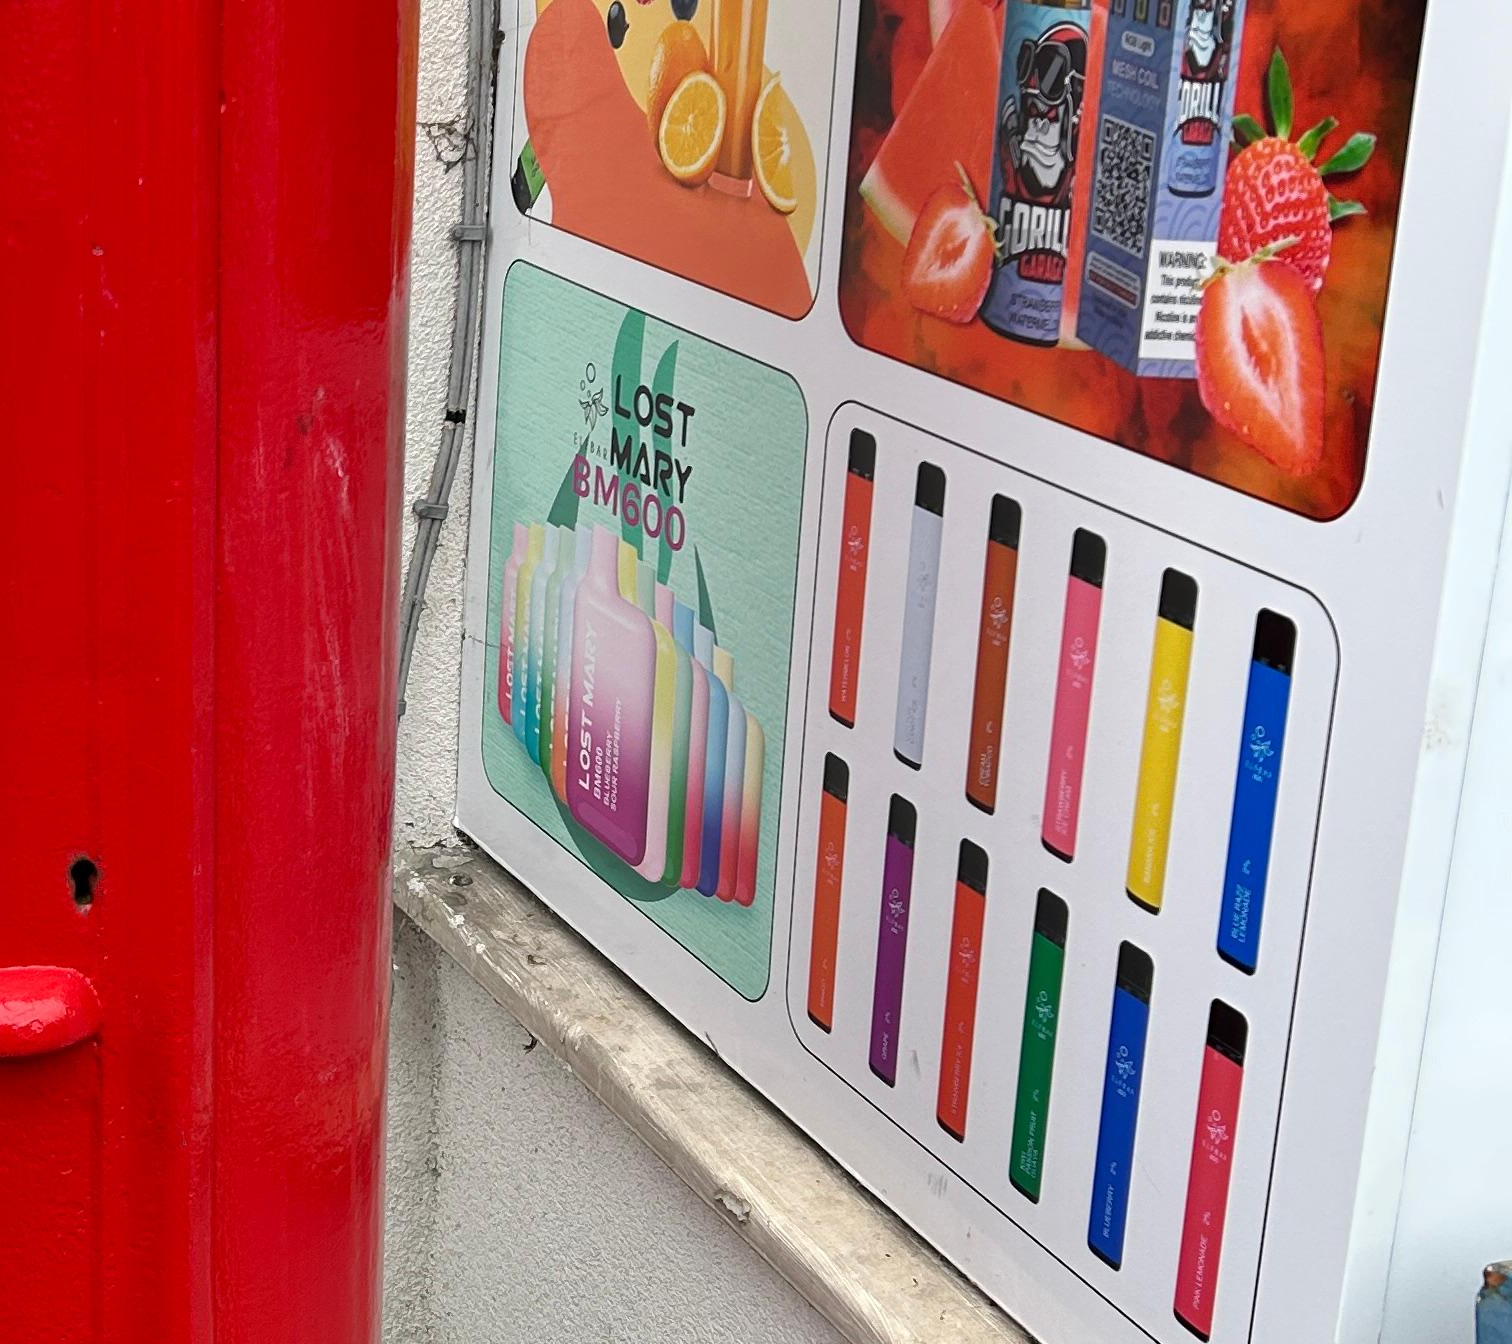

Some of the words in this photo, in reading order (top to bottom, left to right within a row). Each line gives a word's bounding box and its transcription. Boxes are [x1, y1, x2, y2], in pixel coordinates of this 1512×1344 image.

[614, 373, 695, 448] LOST
[572, 452, 686, 552] BM600
[610, 426, 692, 504] MARY
[583, 625, 597, 708] MARY
[579, 709, 592, 791] LOST
[593, 746, 603, 800] BM600
[603, 729, 613, 806] BLUEBERRY
